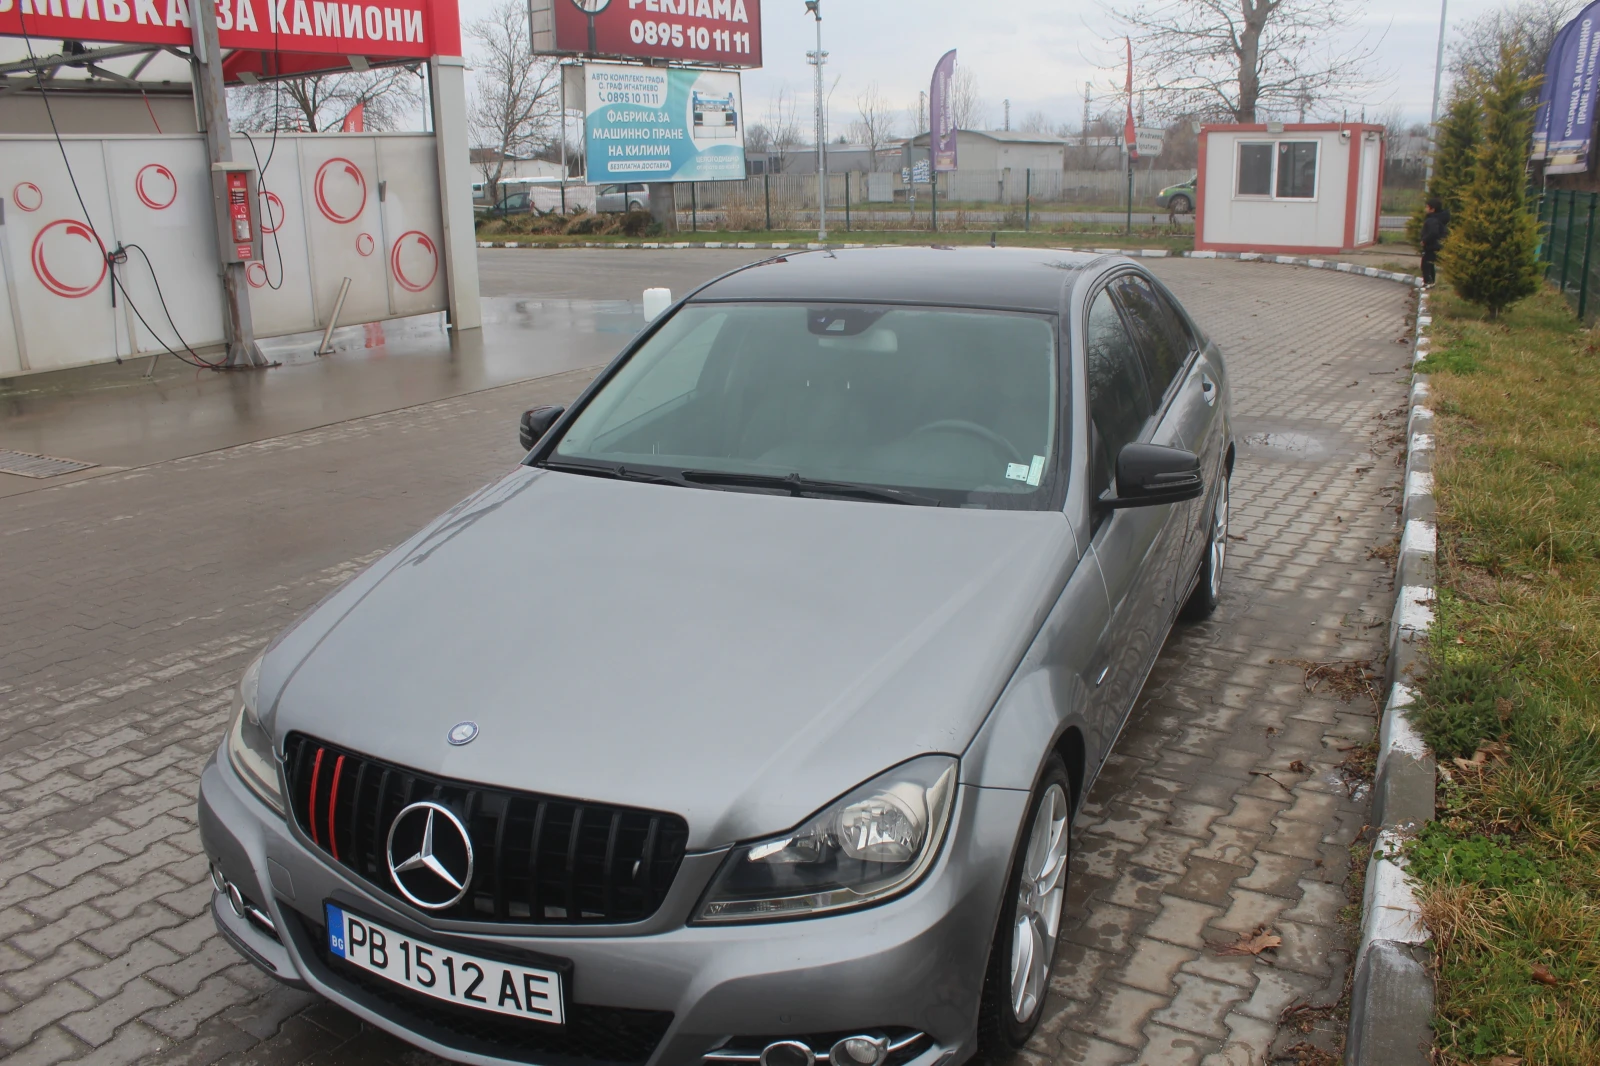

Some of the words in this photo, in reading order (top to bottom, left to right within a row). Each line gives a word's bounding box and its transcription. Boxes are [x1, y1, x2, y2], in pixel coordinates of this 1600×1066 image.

[215, 0, 258, 32] ЗА
[268, 0, 424, 43] КАМИОНИ
[630, 19, 684, 48] 0895
[687, 26, 710, 50] 10
[713, 29, 730, 52] 11
[733, 31, 750, 54] 11
[1575, 18, 1592, 74] МАШИННО
[592, 73, 609, 81] АВТО
[610, 73, 644, 83] КОМПЛЕКС
[1572, 74, 1583, 88] ЗА
[1582, 76, 1593, 91] НА
[607, 82, 623, 90] ГРАФ
[624, 84, 659, 92] ИГНАТИЕВО
[607, 92, 630, 103] 0895
[631, 93, 640, 103] 10
[643, 94, 650, 103] 11
[652, 94, 659, 104] 11
[1564, 89, 1581, 137] ФАБРИКА
[1577, 93, 1589, 124] ПРАНЕ
[607, 109, 656, 123] ФАБРИКА
[657, 112, 670, 123] ЗА
[592, 128, 650, 139] МАШИННО
[652, 128, 683, 139] ПРАНЕ
[608, 145, 623, 156] НА
[625, 145, 670, 156] КИЛИМИ
[641, 162, 669, 170] ДОСТАВКА
[331, 935, 344, 950] BG
[348, 917, 388, 969] PB
[399, 940, 487, 1003] 1512
[498, 969, 553, 1016] AE
